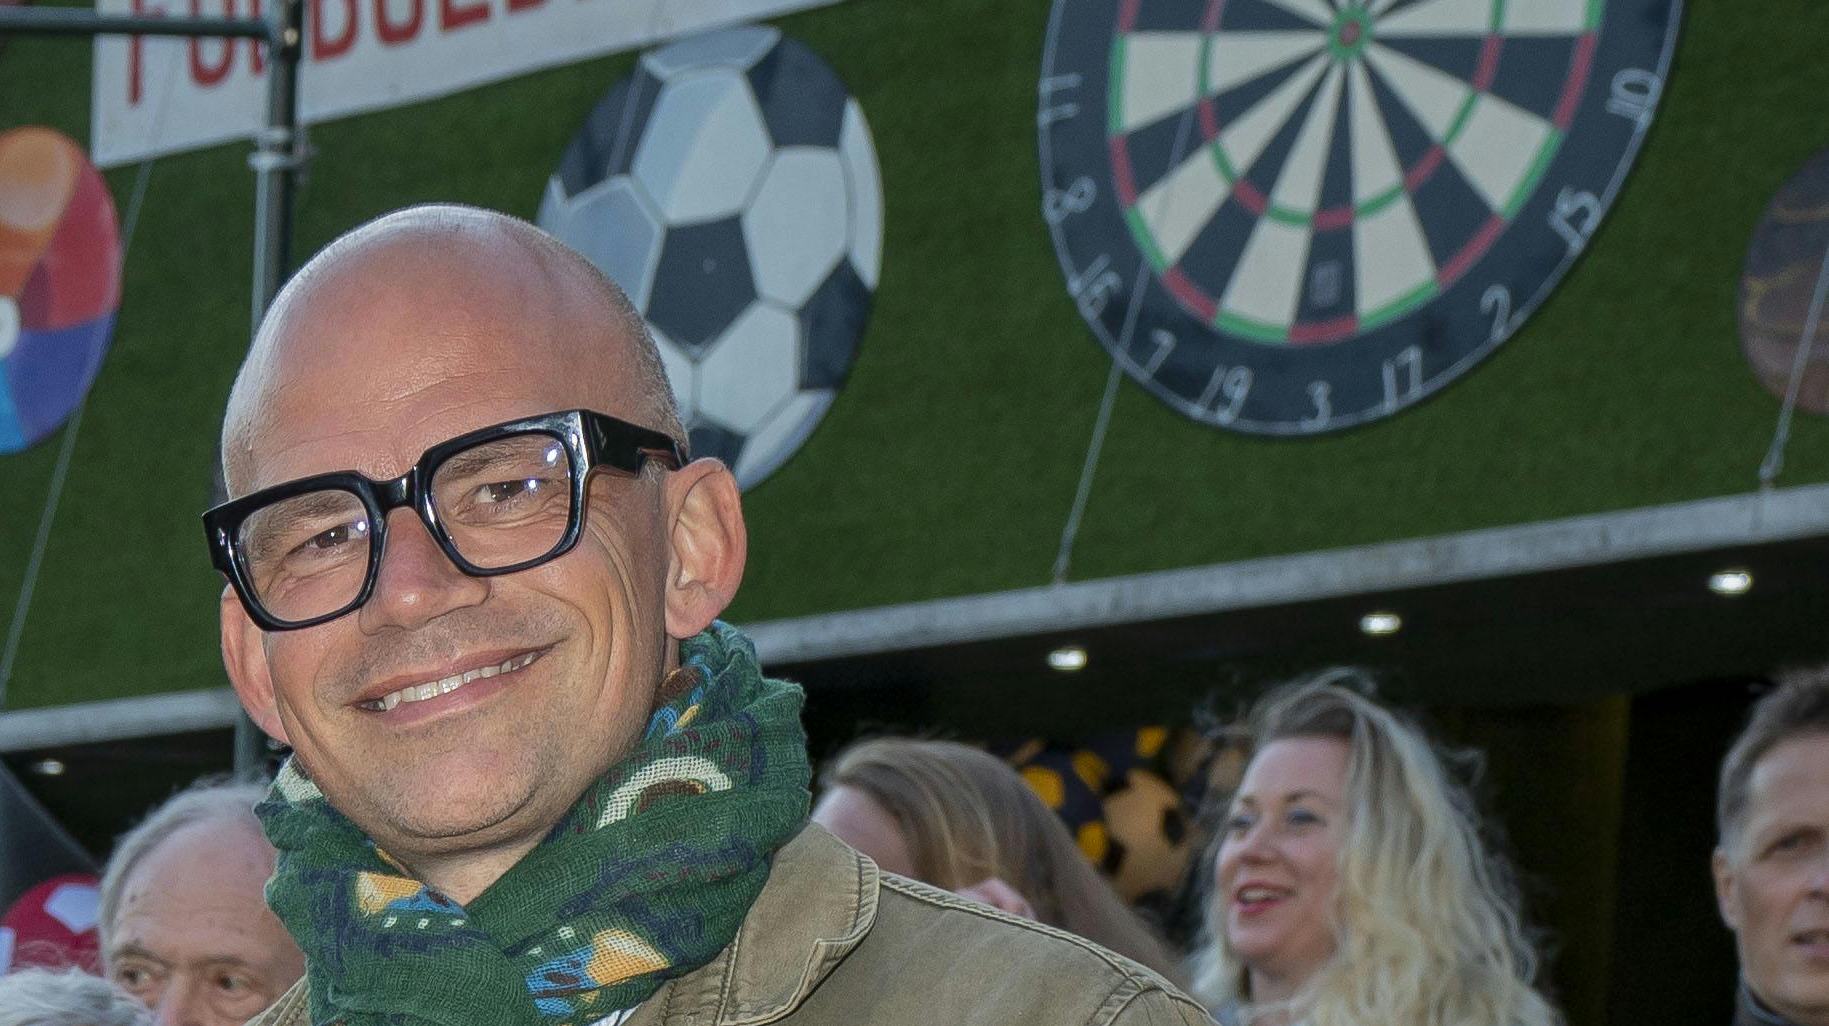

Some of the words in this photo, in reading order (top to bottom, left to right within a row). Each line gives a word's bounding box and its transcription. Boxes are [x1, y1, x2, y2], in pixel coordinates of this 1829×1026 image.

[1037, 72, 1083, 128] 11
[1605, 67, 1663, 132] 10
[1041, 175, 1099, 226] 8
[1546, 186, 1602, 254] 15
[1067, 253, 1122, 323] 16
[1479, 283, 1525, 345] 2
[1139, 329, 1177, 382] 7
[1381, 345, 1423, 416] 17
[1189, 365, 1254, 425] 19
[1300, 380, 1332, 433] 3
